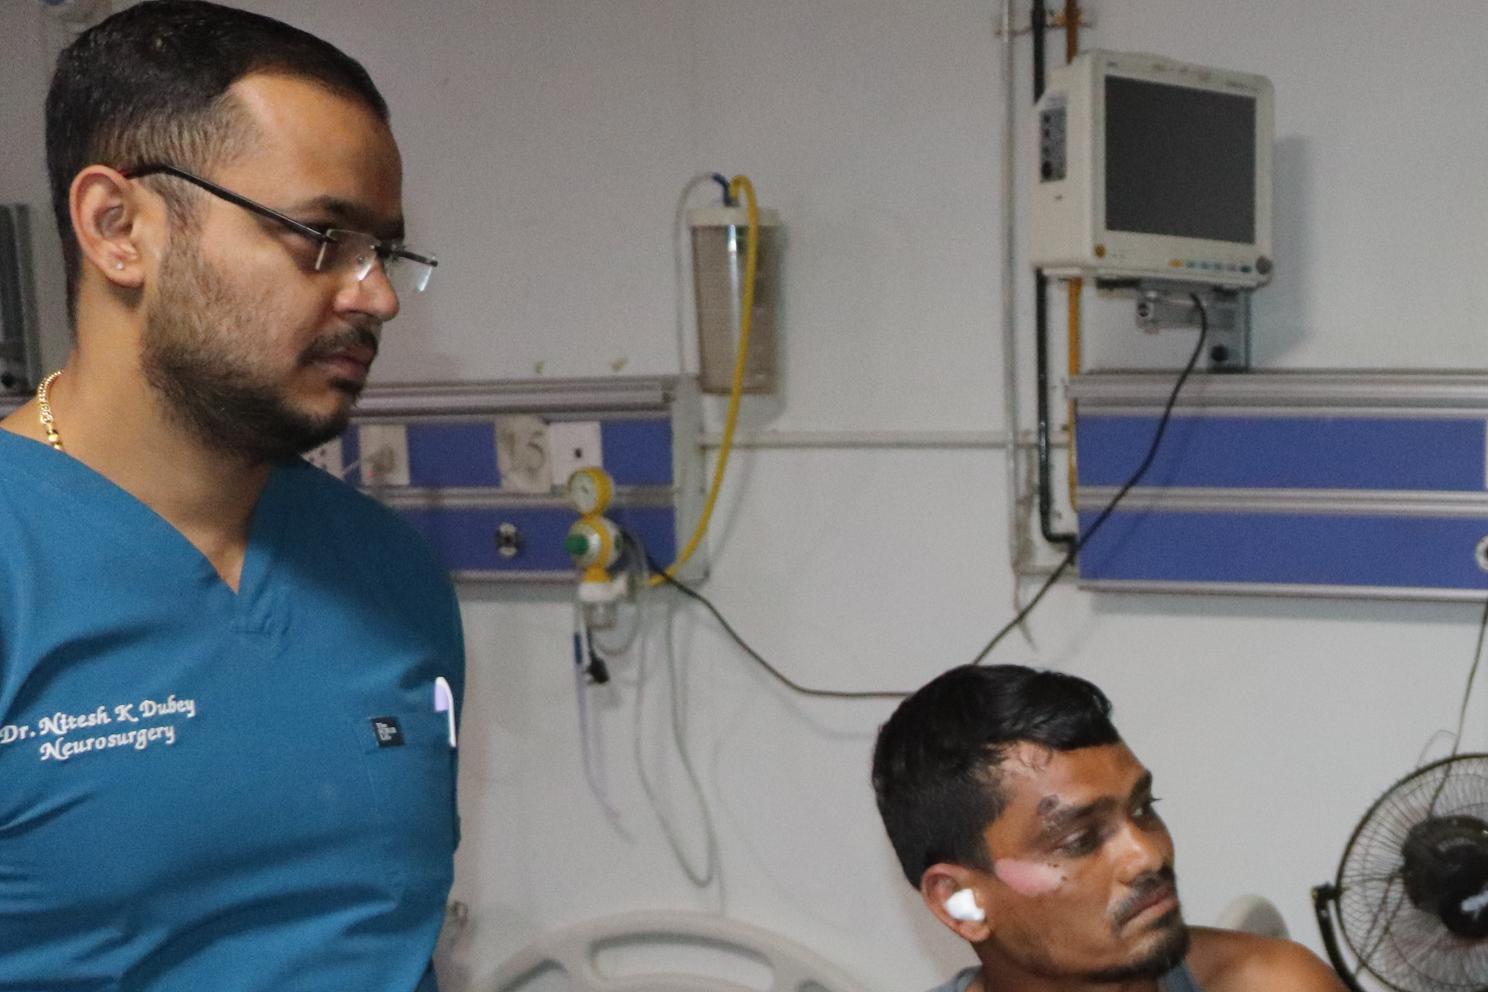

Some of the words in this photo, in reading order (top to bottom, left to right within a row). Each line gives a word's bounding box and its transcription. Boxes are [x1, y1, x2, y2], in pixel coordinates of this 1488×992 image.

[0, 724, 36, 744] Dr.
[38, 705, 112, 735] Nitesh
[114, 703, 139, 722] K
[139, 694, 196, 718] Dubey
[39, 725, 176, 761] Neurosurgery
